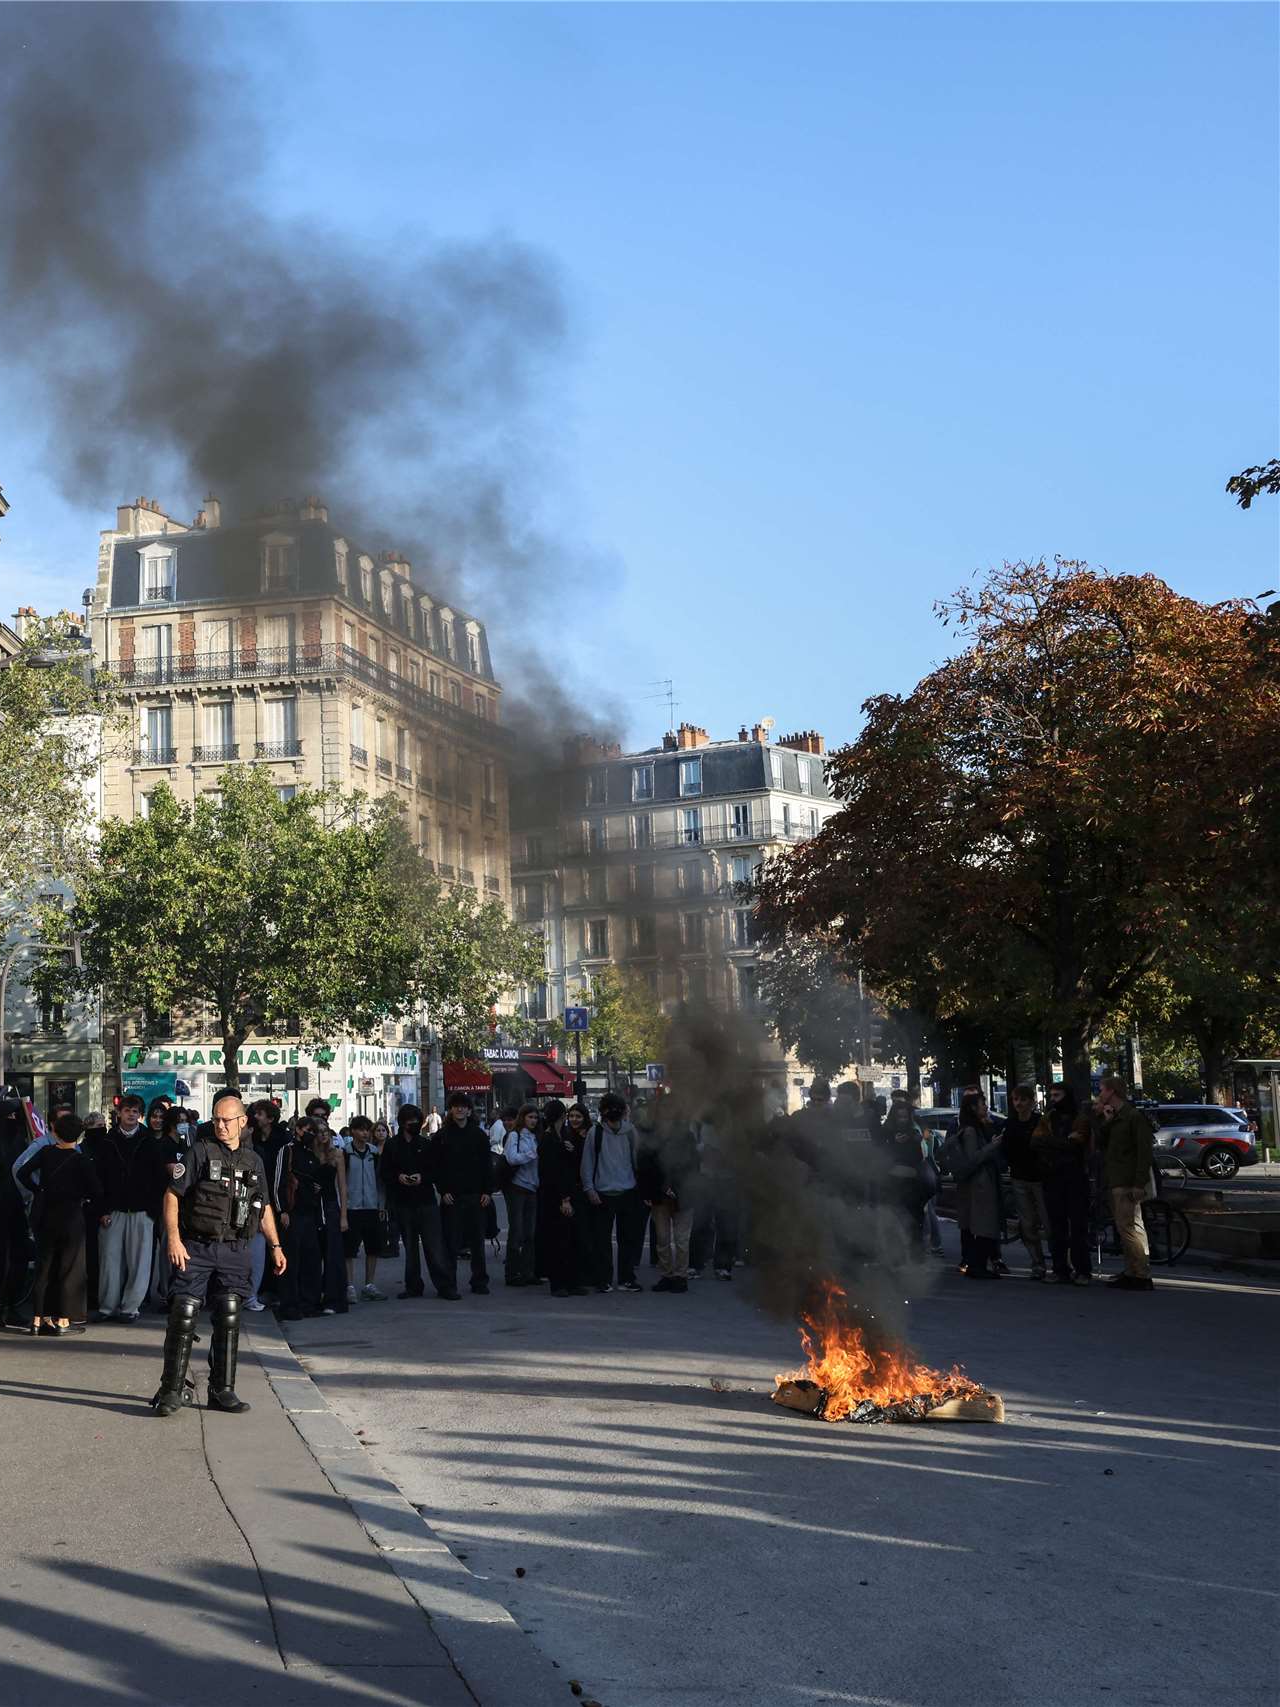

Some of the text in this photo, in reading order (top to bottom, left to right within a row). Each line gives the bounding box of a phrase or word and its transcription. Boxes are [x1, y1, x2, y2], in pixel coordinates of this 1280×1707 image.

[360, 1050, 407, 1067] PHARMACIE
[483, 1048, 499, 1058] TABAC
[504, 1049, 519, 1059] CANON
